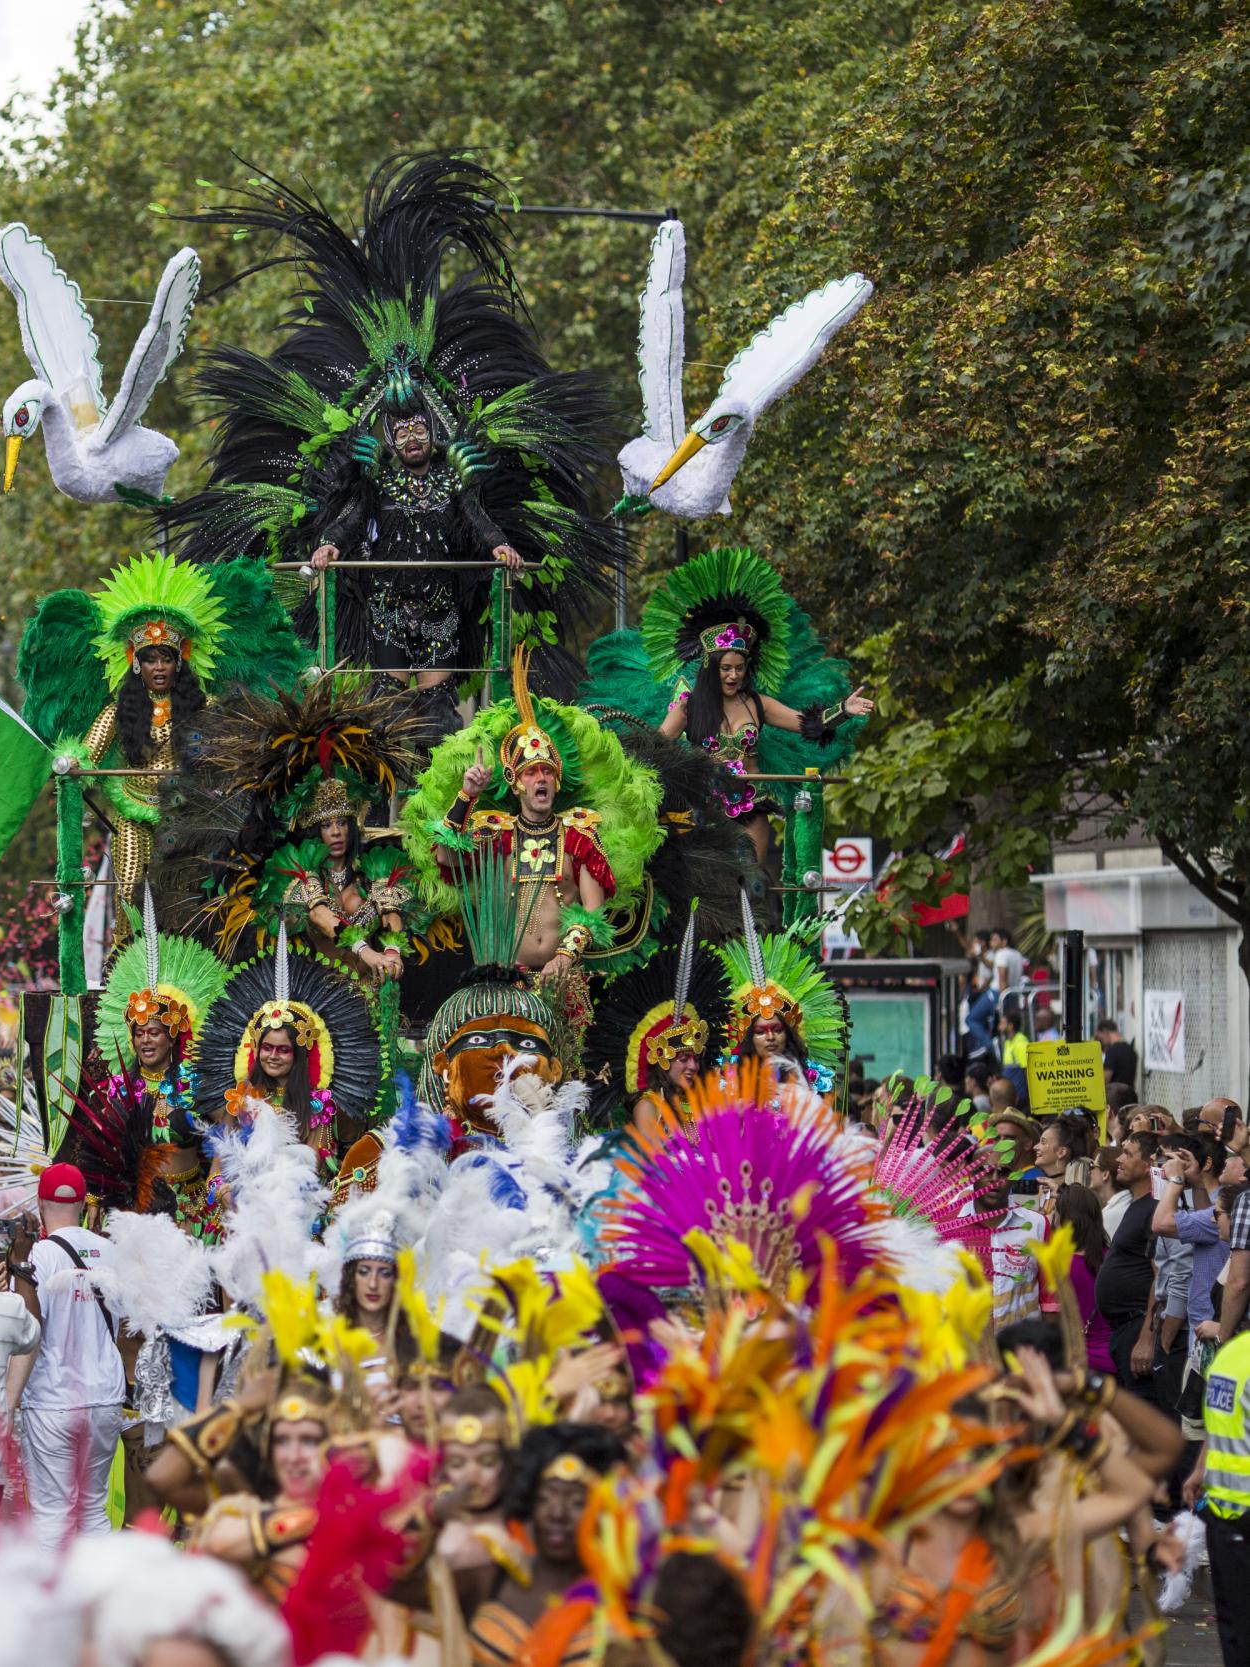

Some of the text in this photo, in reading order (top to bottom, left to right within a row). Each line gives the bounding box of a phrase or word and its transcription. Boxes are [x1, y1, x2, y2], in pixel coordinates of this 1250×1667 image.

[1034, 1060, 1046, 1068] City
[1056, 1058, 1094, 1066] Westminster
[1036, 1068, 1095, 1081] WARNING
[1047, 1086, 1086, 1095] SUSPENDED
[1207, 1388, 1233, 1410] PLICE
